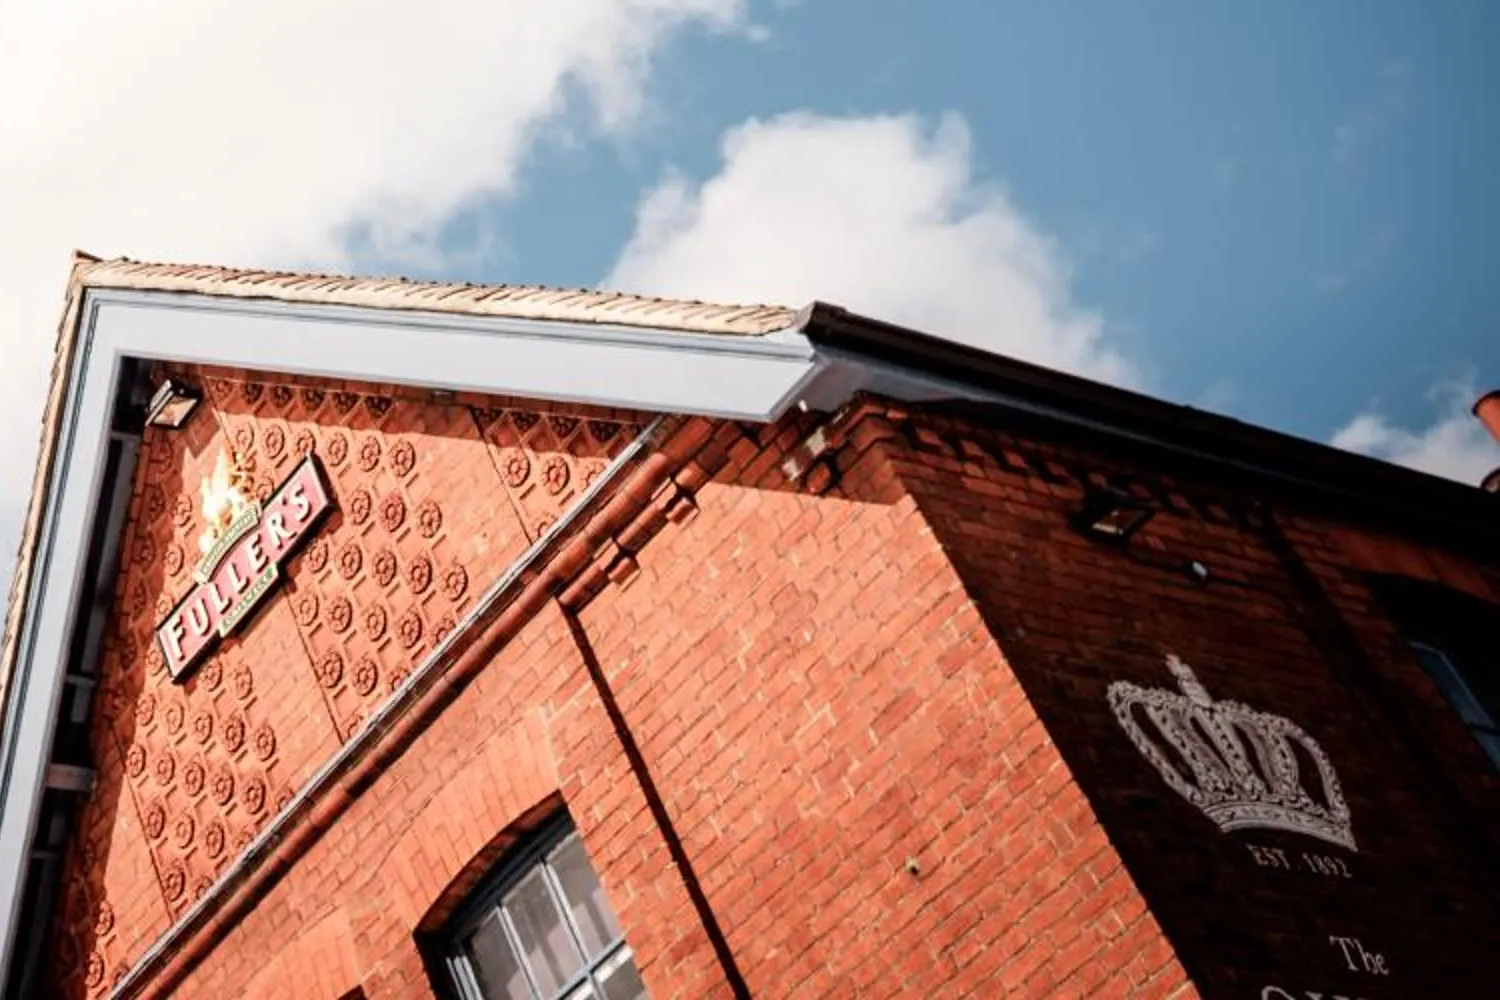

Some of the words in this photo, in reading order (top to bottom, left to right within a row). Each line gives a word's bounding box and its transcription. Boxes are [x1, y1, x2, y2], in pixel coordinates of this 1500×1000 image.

[166, 481, 311, 661] FULLER'S
[1301, 852, 1354, 879] 1892
[1328, 934, 1390, 977] The
